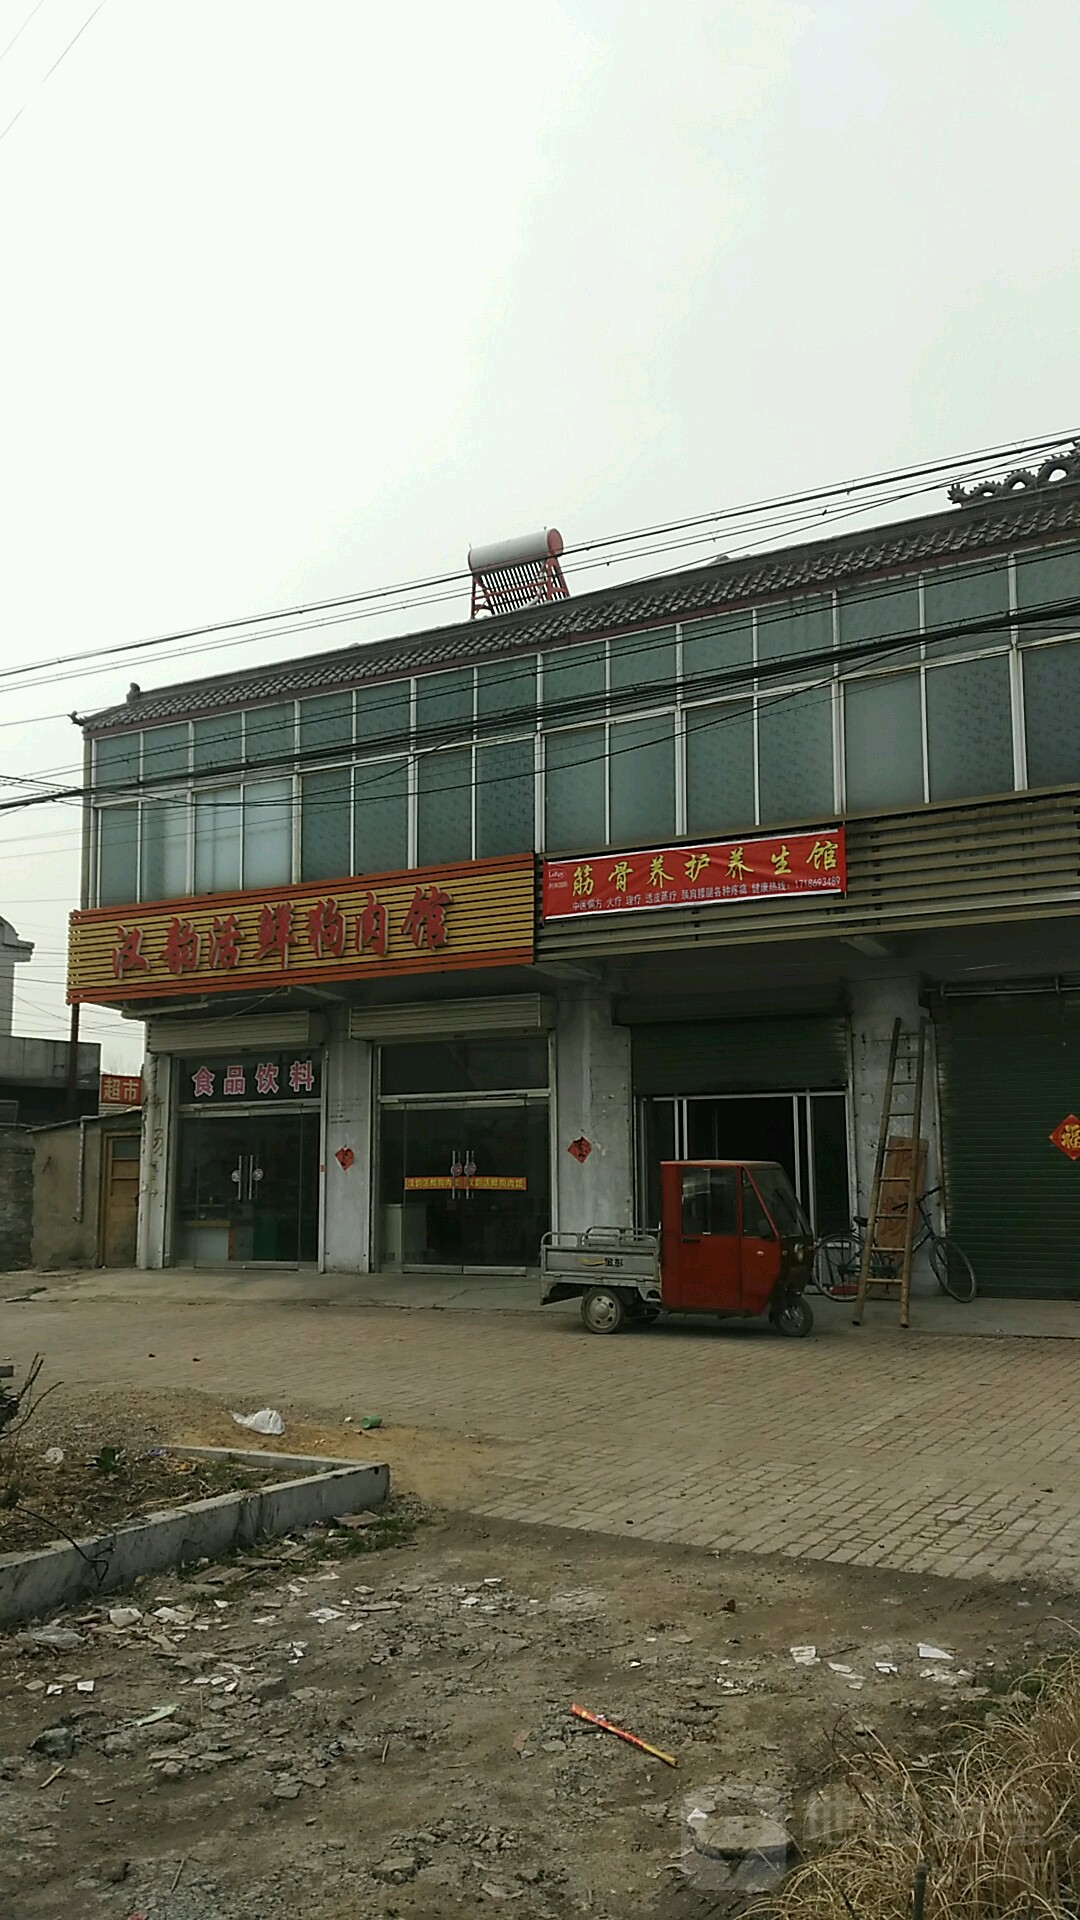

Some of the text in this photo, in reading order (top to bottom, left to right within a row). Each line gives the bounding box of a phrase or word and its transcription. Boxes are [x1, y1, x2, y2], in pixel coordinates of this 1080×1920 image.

[571, 840, 840, 897] 筋骨养护养生馆
[112, 886, 453, 979] 汉韵活鲜狗肉馆
[103, 1077, 139, 1101] 超市
[191, 1060, 315, 1097] 食品饮料
[1061, 1124, 1080, 1150] 福
